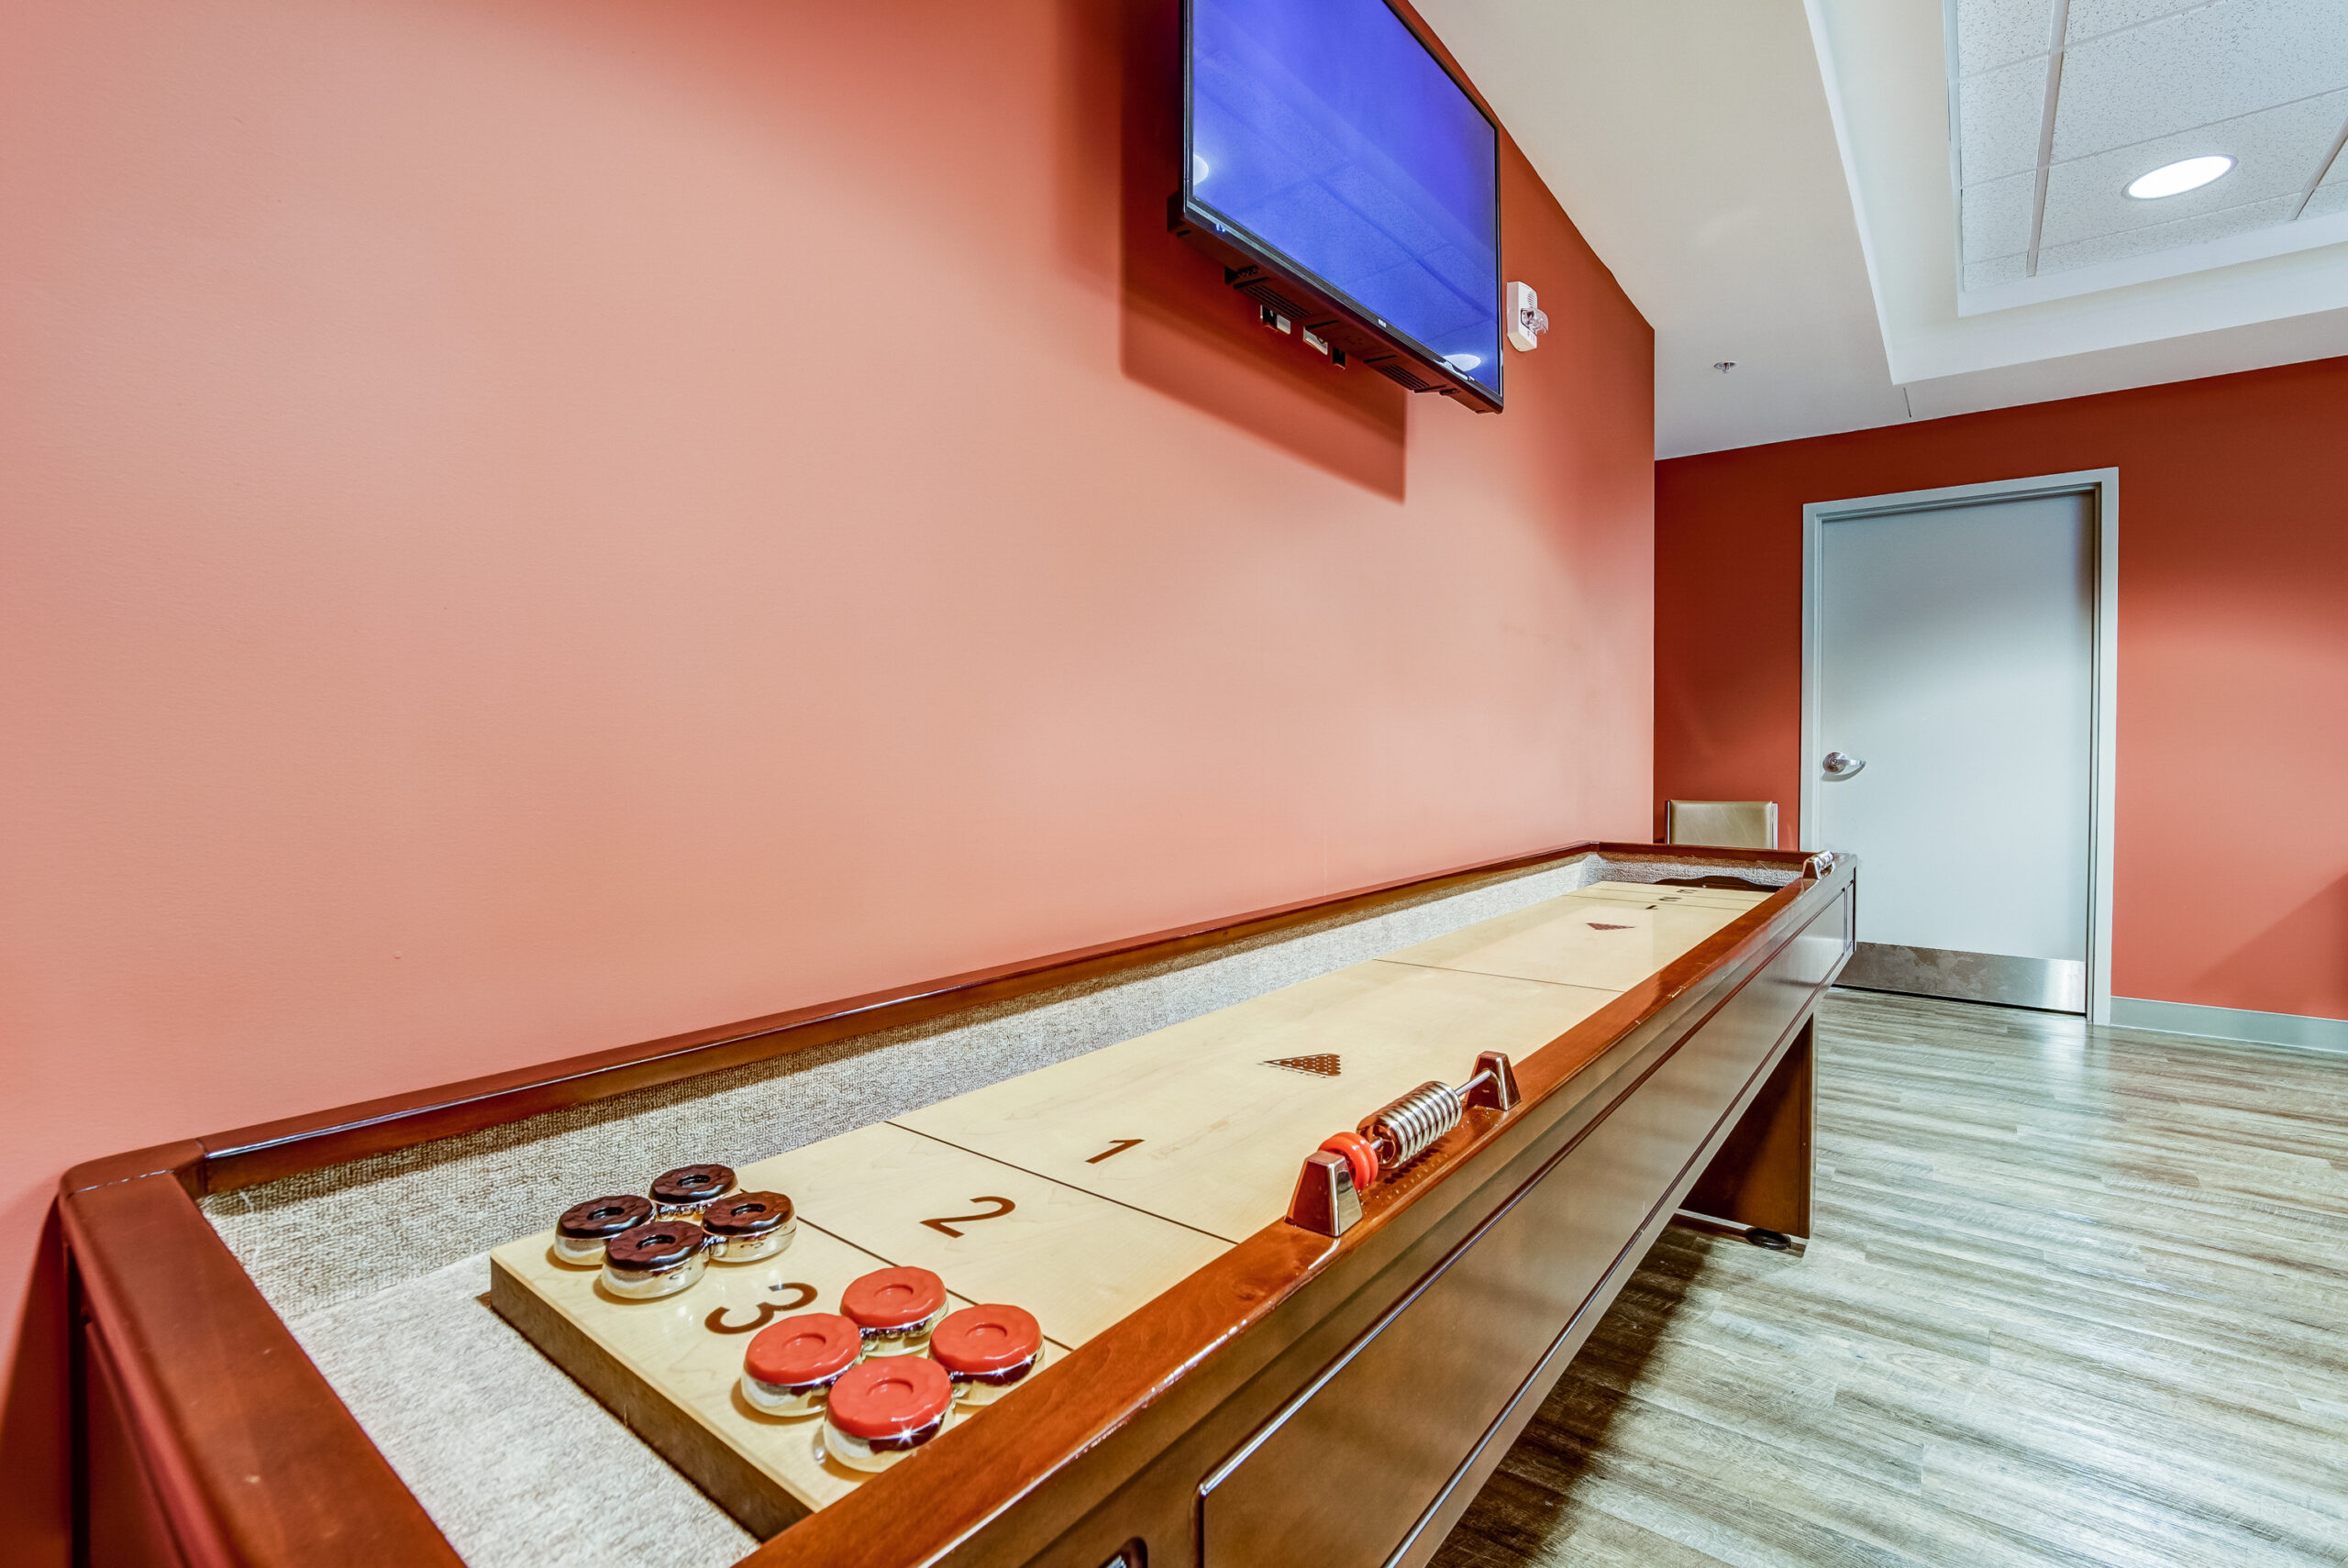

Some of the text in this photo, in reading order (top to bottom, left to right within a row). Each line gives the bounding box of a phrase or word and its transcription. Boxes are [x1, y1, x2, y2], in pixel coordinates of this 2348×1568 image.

[1085, 1138, 1146, 1165] 1
[919, 1196, 1016, 1239] 2
[703, 1281, 818, 1335] 3
